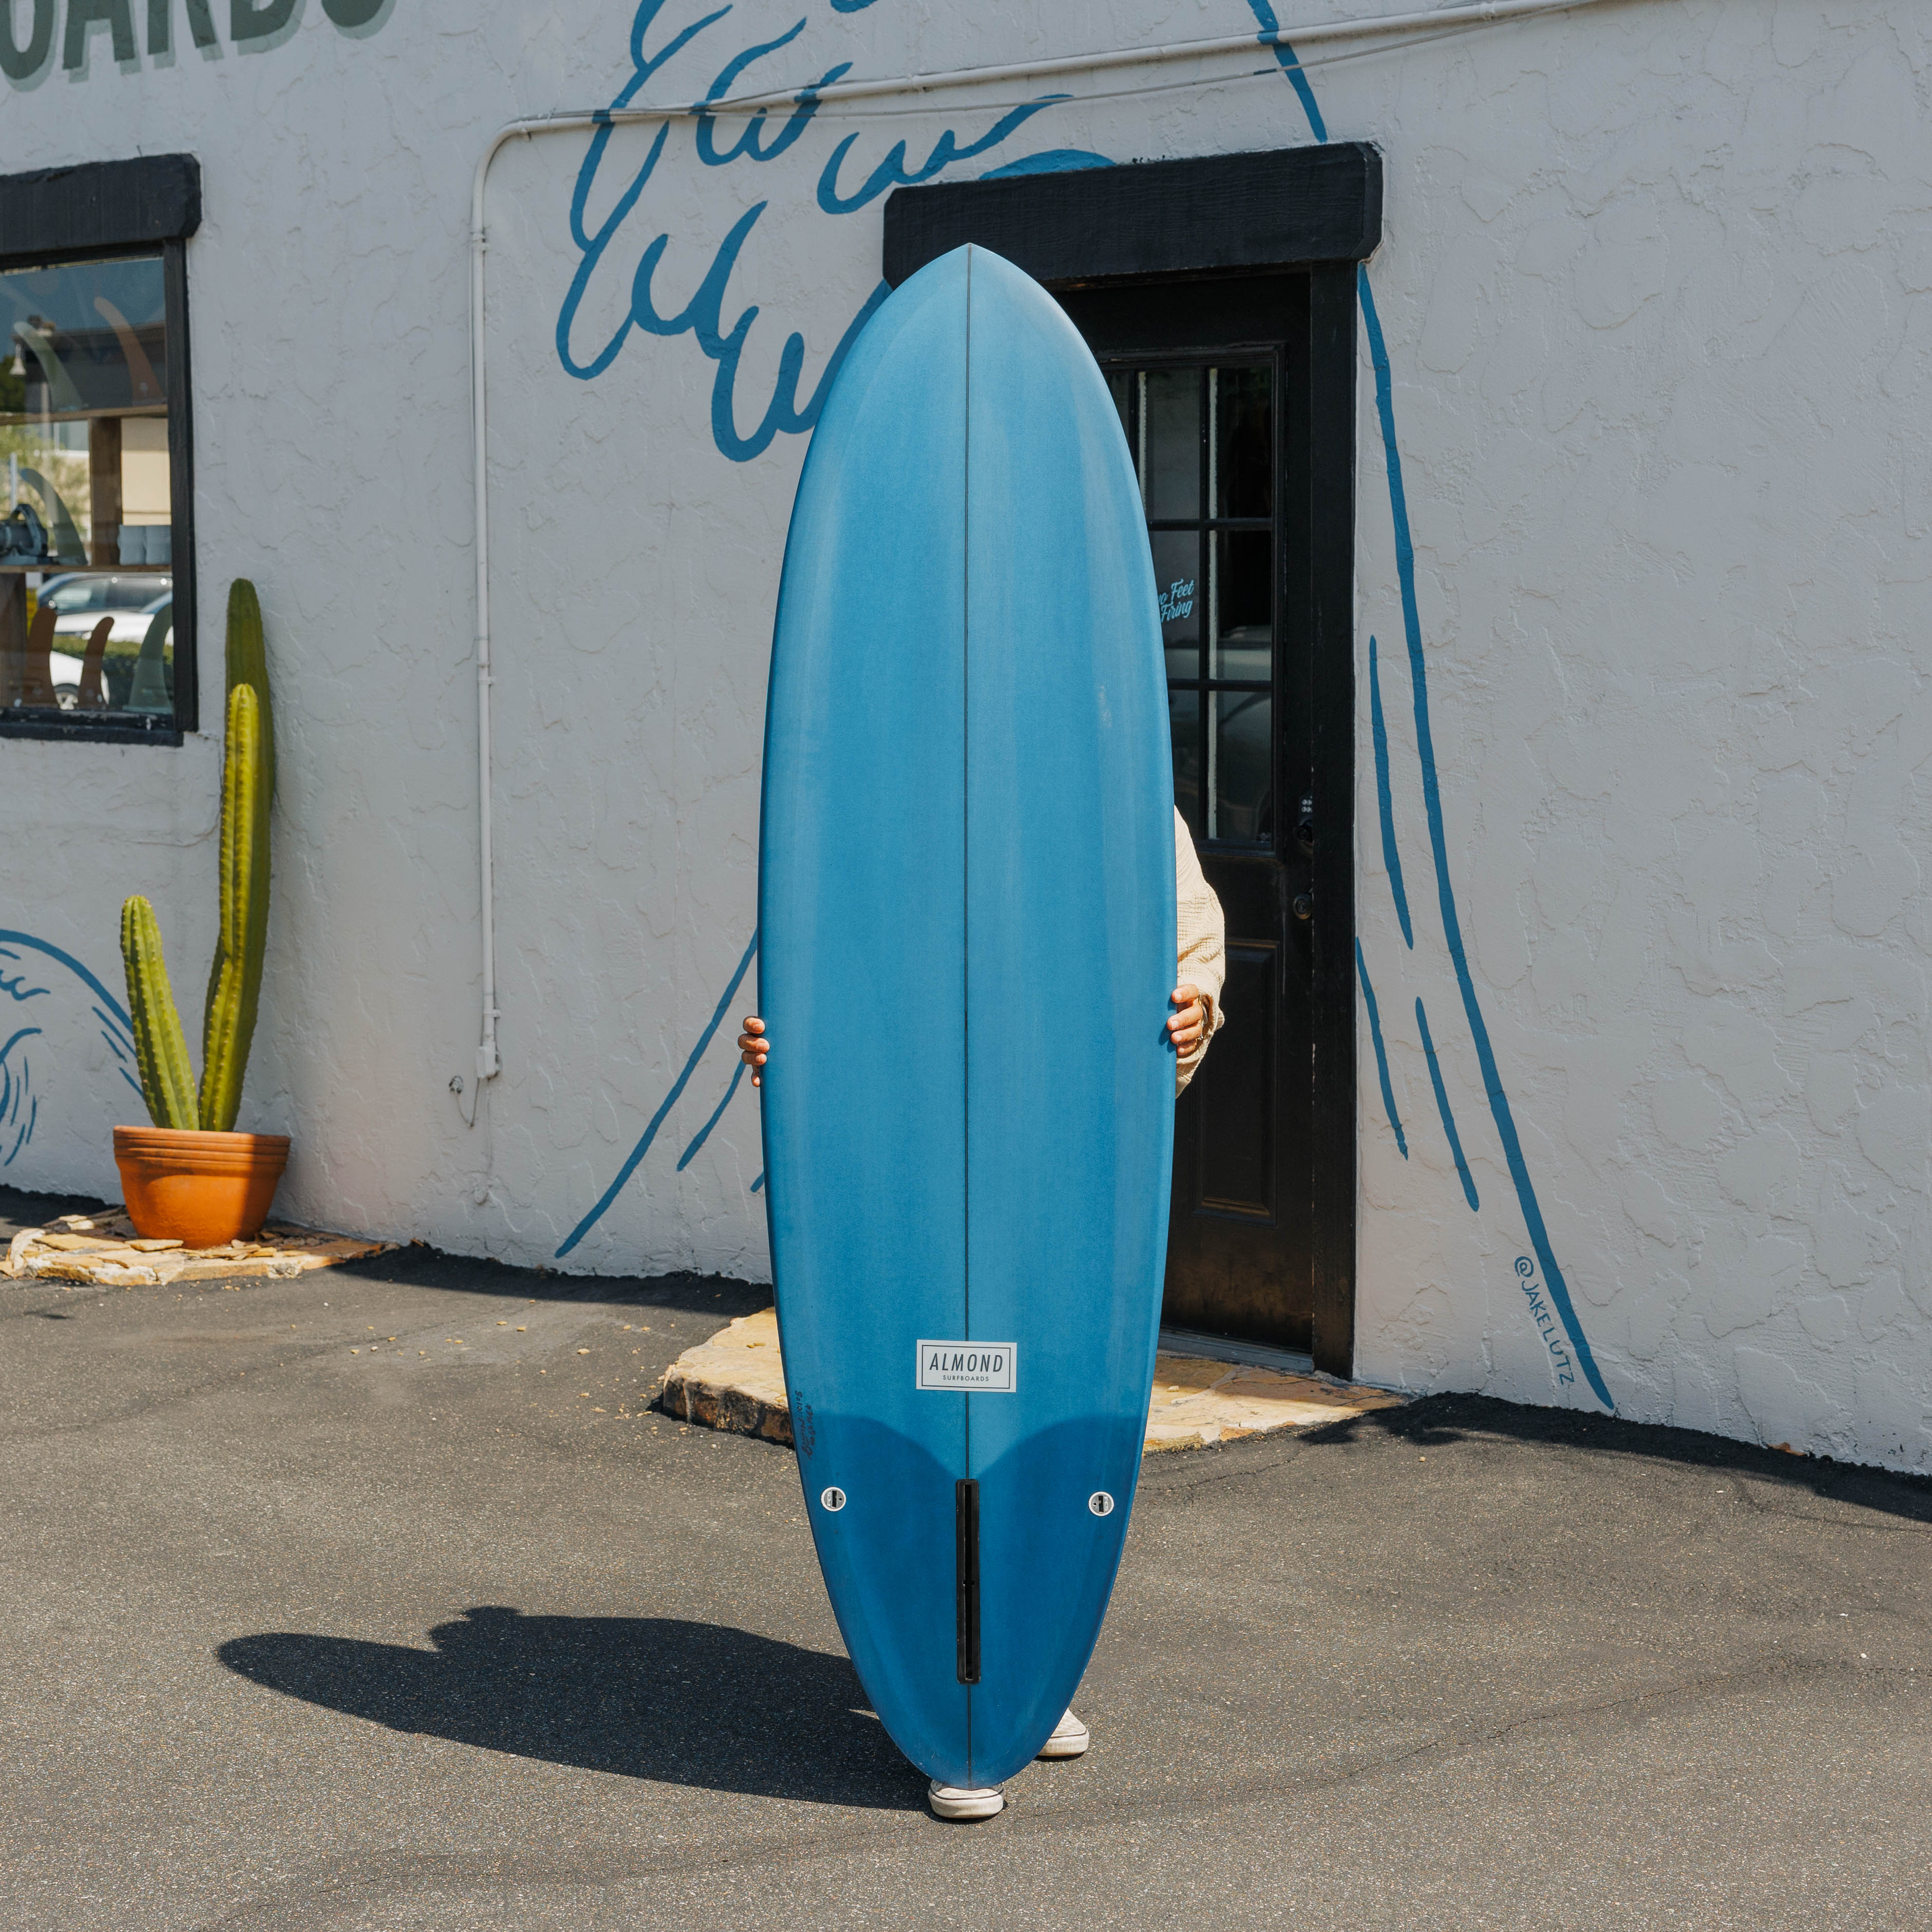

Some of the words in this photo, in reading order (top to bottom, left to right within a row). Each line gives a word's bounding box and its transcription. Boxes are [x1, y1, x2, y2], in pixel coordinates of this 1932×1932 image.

[1171, 578, 1195, 600] Feet
[1161, 600, 1193, 622] Firing
[929, 1353, 1003, 1372] ALMOND
